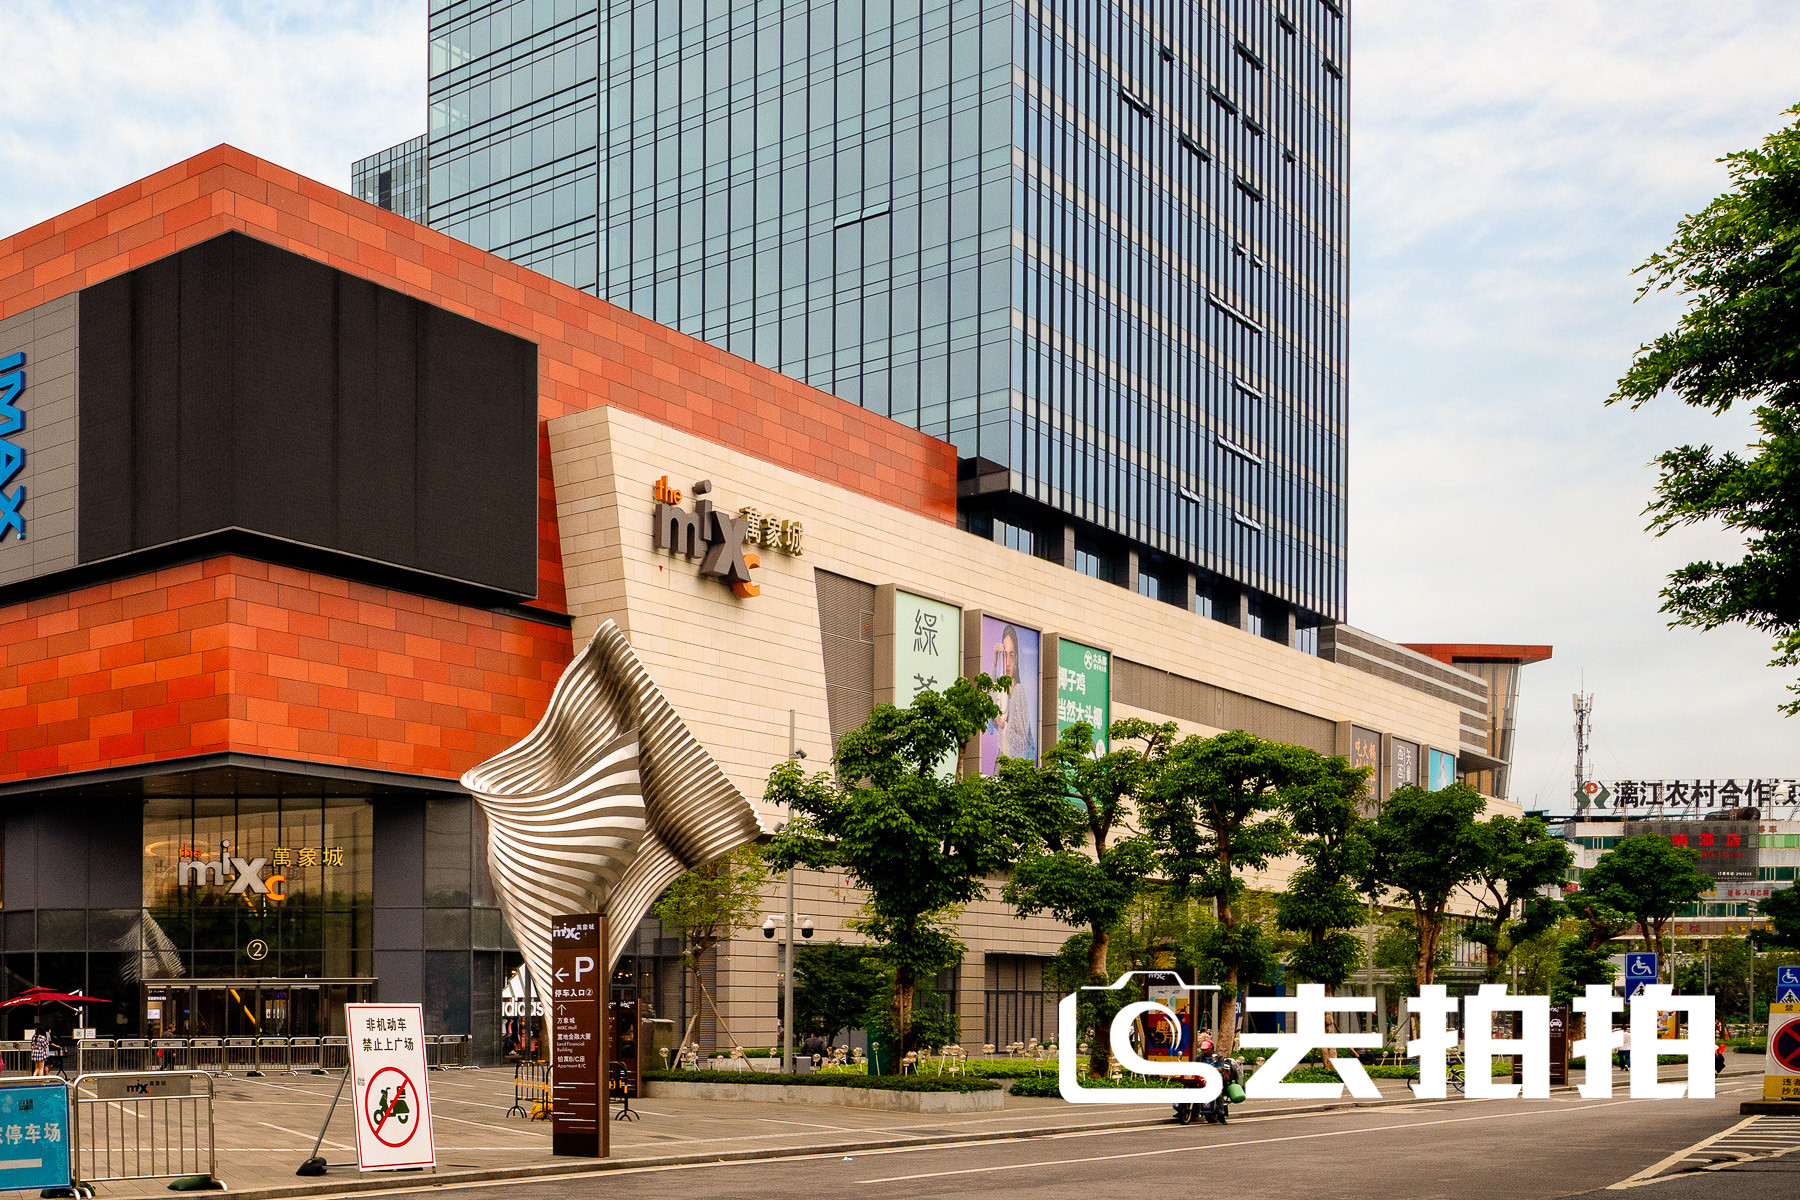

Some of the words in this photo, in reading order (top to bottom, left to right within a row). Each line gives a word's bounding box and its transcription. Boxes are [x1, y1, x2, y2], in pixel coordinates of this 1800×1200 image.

[655, 475, 682, 505] the
[179, 842, 202, 859] the
[273, 846, 344, 868] 萬象城
[575, 956, 595, 983] P
[366, 1018, 407, 1032] 非机动车
[362, 1038, 414, 1052] 禁止上广场
